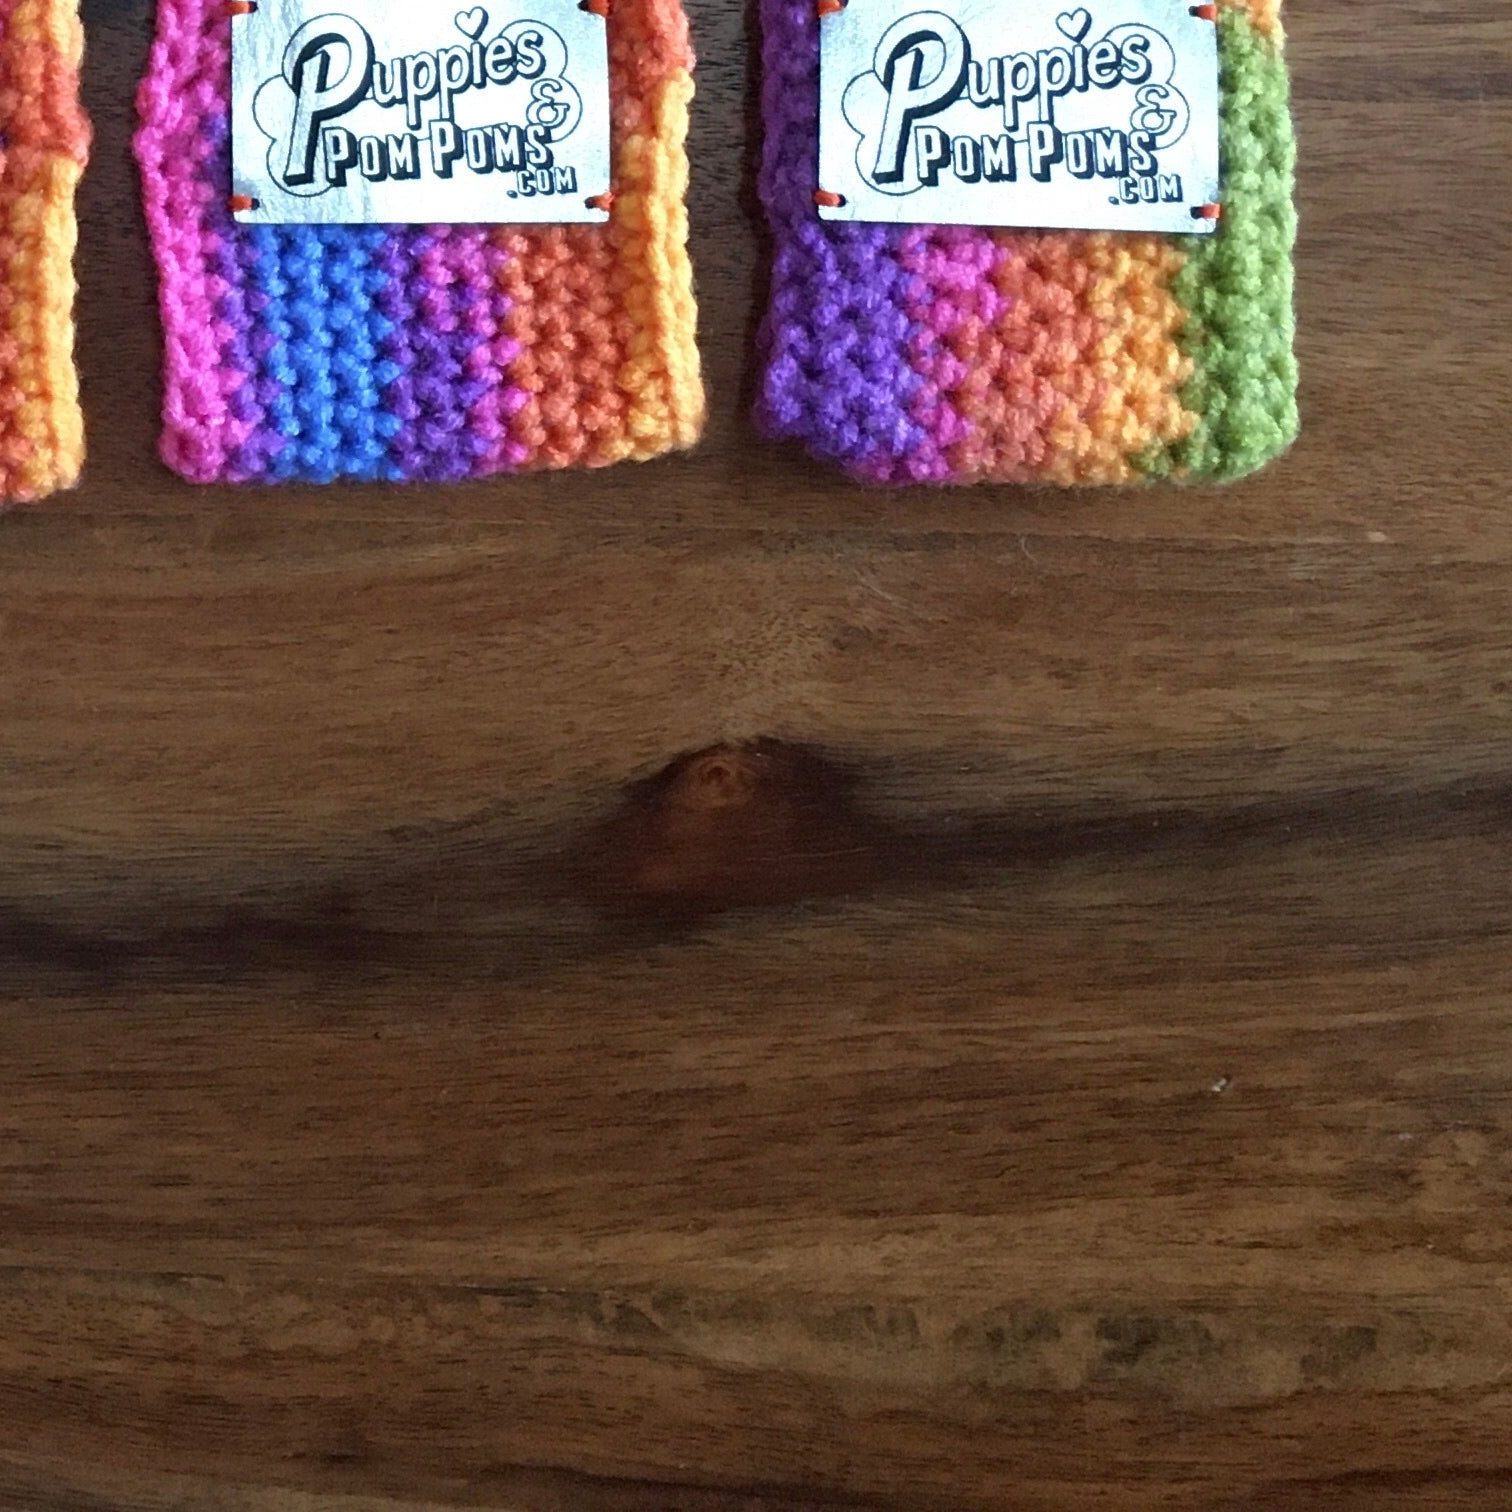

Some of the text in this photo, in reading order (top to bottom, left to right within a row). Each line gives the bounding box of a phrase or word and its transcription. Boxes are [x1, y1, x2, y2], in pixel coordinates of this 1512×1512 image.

[282, 6, 546, 186] Puppies
[526, 78, 570, 127] &
[872, 8, 1152, 184] Puppies
[1131, 84, 1176, 134] &
